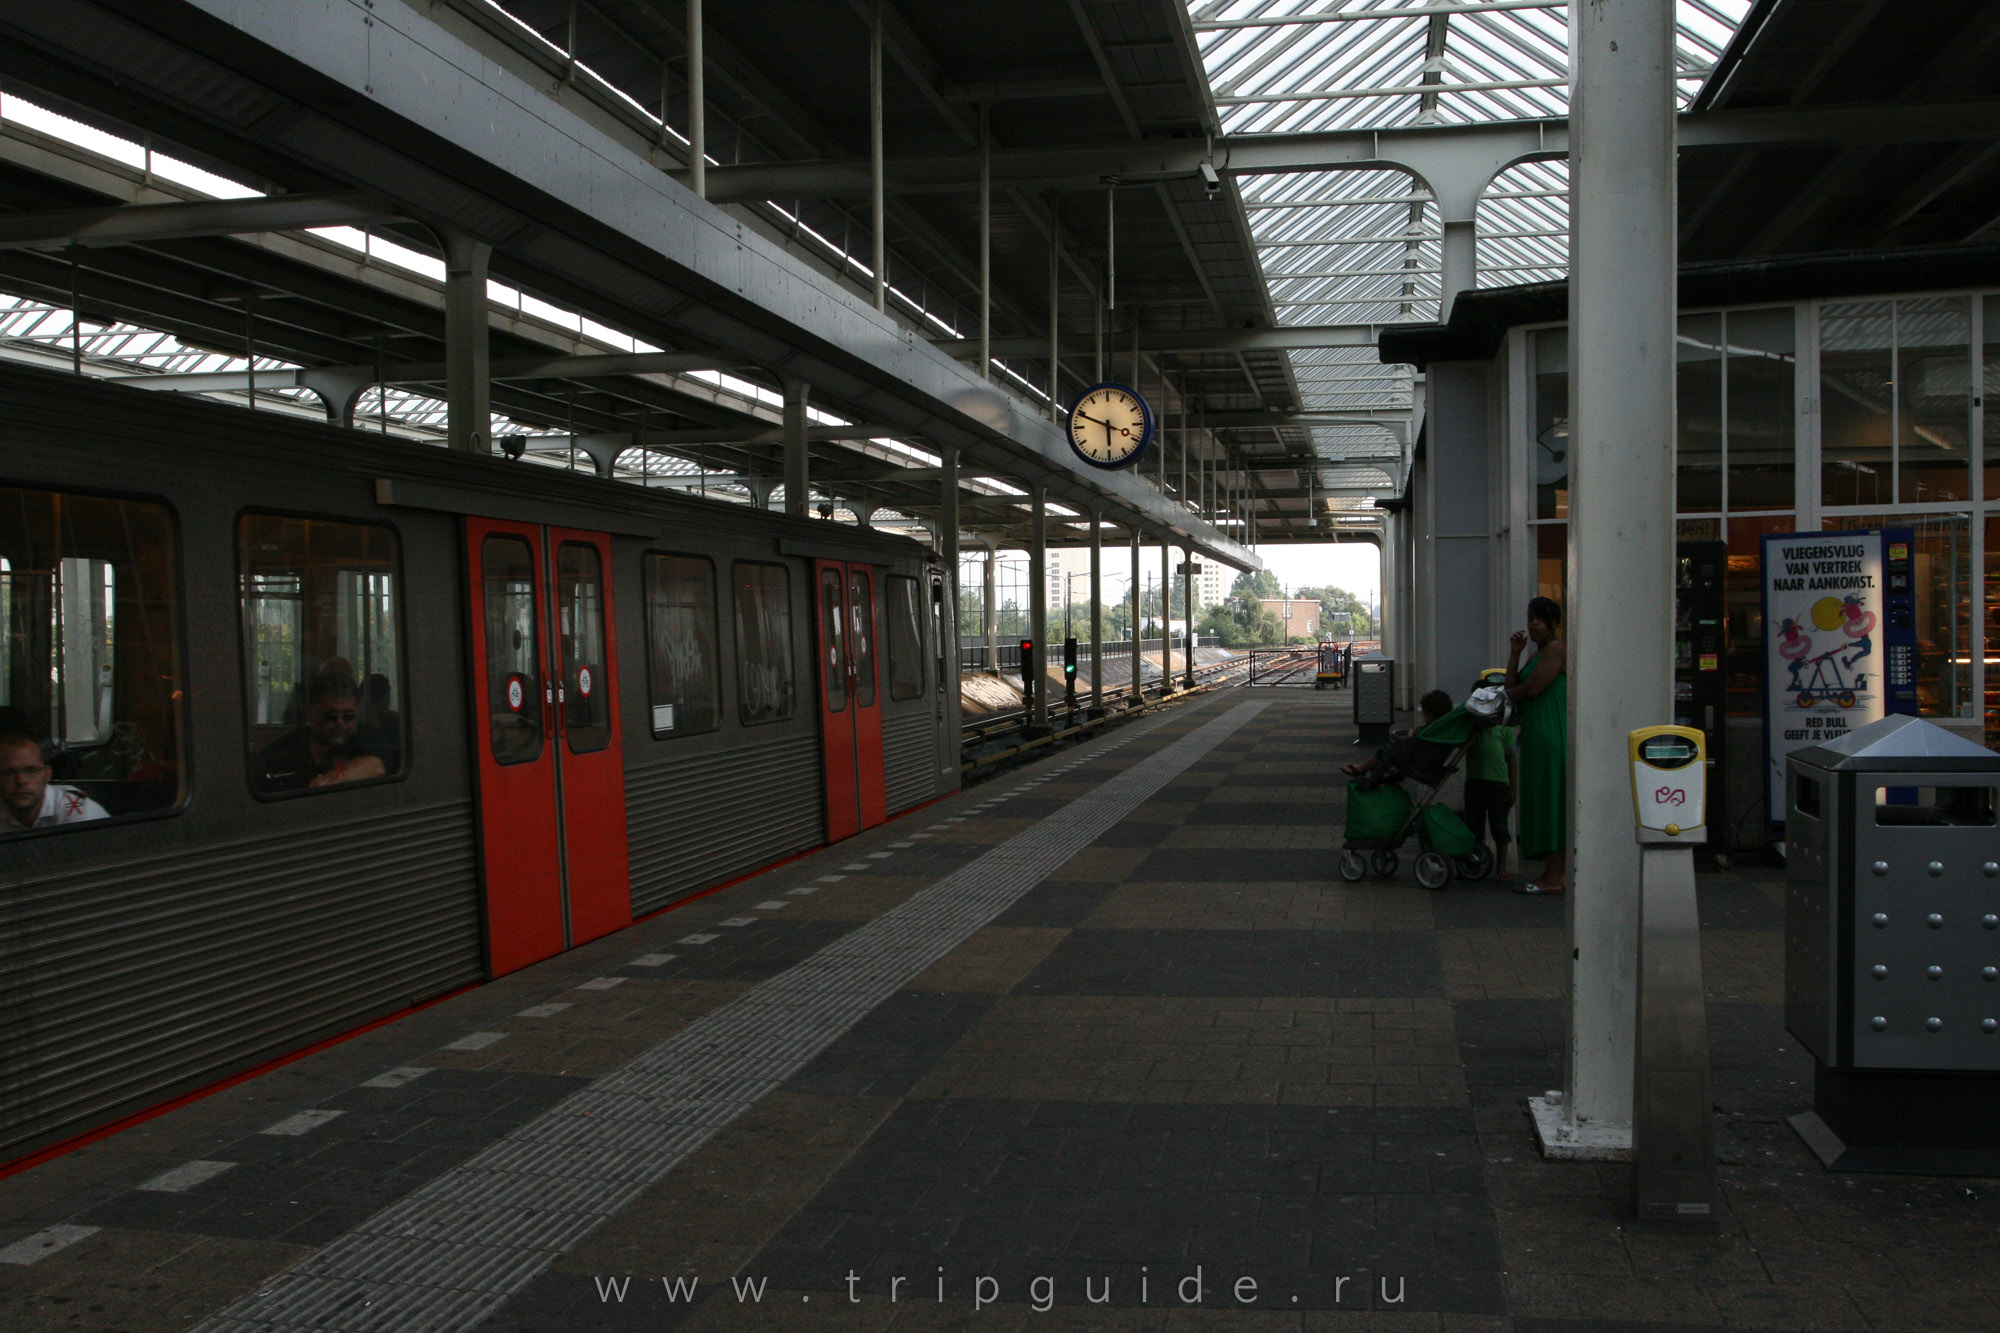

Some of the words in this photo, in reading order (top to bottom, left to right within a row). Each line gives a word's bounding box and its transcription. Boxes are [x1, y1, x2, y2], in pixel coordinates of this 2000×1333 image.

[1782, 545, 1865, 560] VLIEGENSVLUG
[1786, 562, 1809, 575] VAN
[1813, 560, 1862, 574] VERTREK
[1774, 578, 1805, 591] NAAR
[1808, 575, 1875, 590] AANKOMST.
[1806, 717, 1823, 728] RED
[1826, 717, 1848, 728] BULL
[1784, 729, 1809, 740] GEEFT
[1812, 729, 1822, 740] JE
